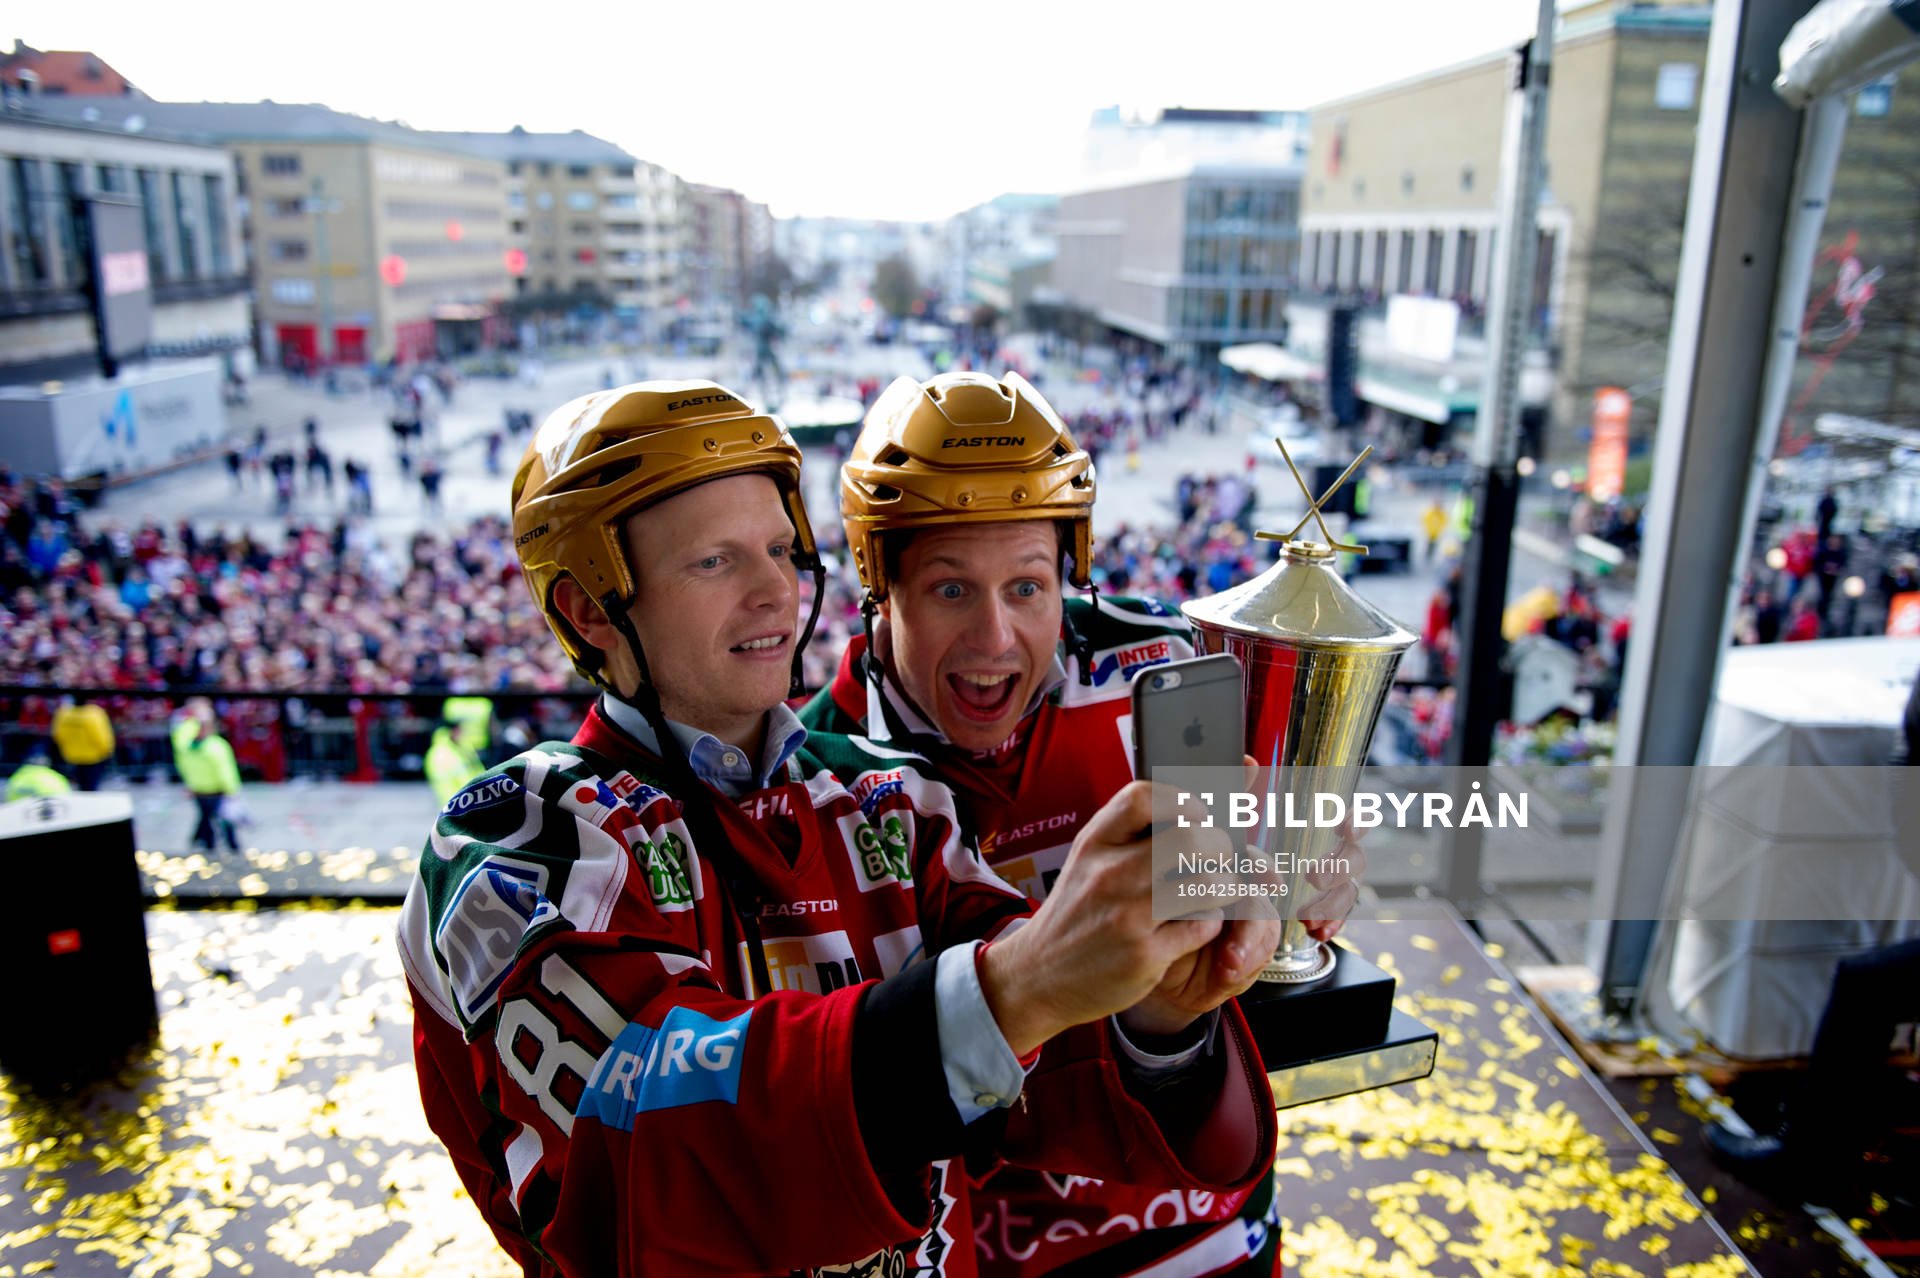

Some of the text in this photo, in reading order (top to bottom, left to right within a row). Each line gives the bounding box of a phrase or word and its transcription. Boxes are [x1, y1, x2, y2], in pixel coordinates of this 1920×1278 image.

[941, 436, 1025, 449] EASTON
[1117, 641, 1169, 667] INTER
[442, 777, 520, 814] VOLVO
[994, 811, 1077, 846] EASTON
[495, 952, 628, 1138] 81
